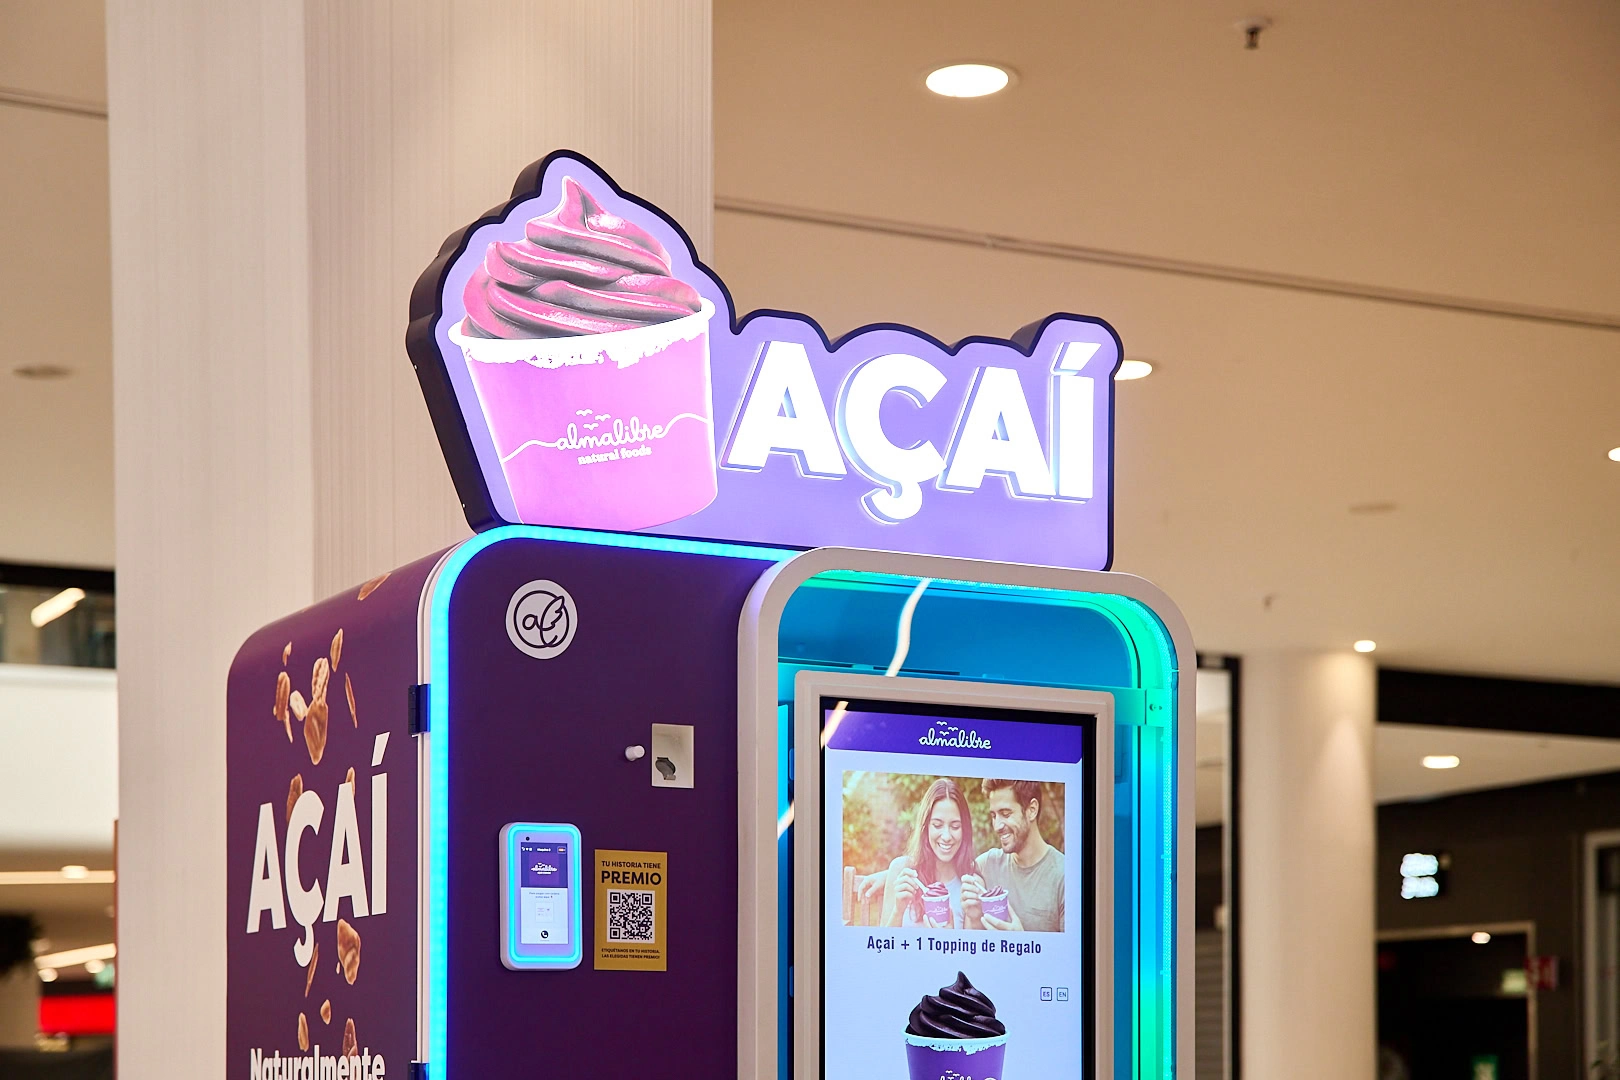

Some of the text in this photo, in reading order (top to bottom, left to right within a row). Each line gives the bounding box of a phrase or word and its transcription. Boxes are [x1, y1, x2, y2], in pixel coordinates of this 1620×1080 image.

[556, 416, 663, 450] almalibre
[720, 341, 1101, 523] AÇAÍ
[577, 444, 652, 465] natural foods
[918, 727, 991, 749] almalibre
[246, 731, 390, 967] AÇAÍ
[601, 870, 662, 886] PREMIO
[867, 935, 1042, 956] Açai + 1 Topping de Regalo
[250, 1044, 386, 1080] Naturalmente
